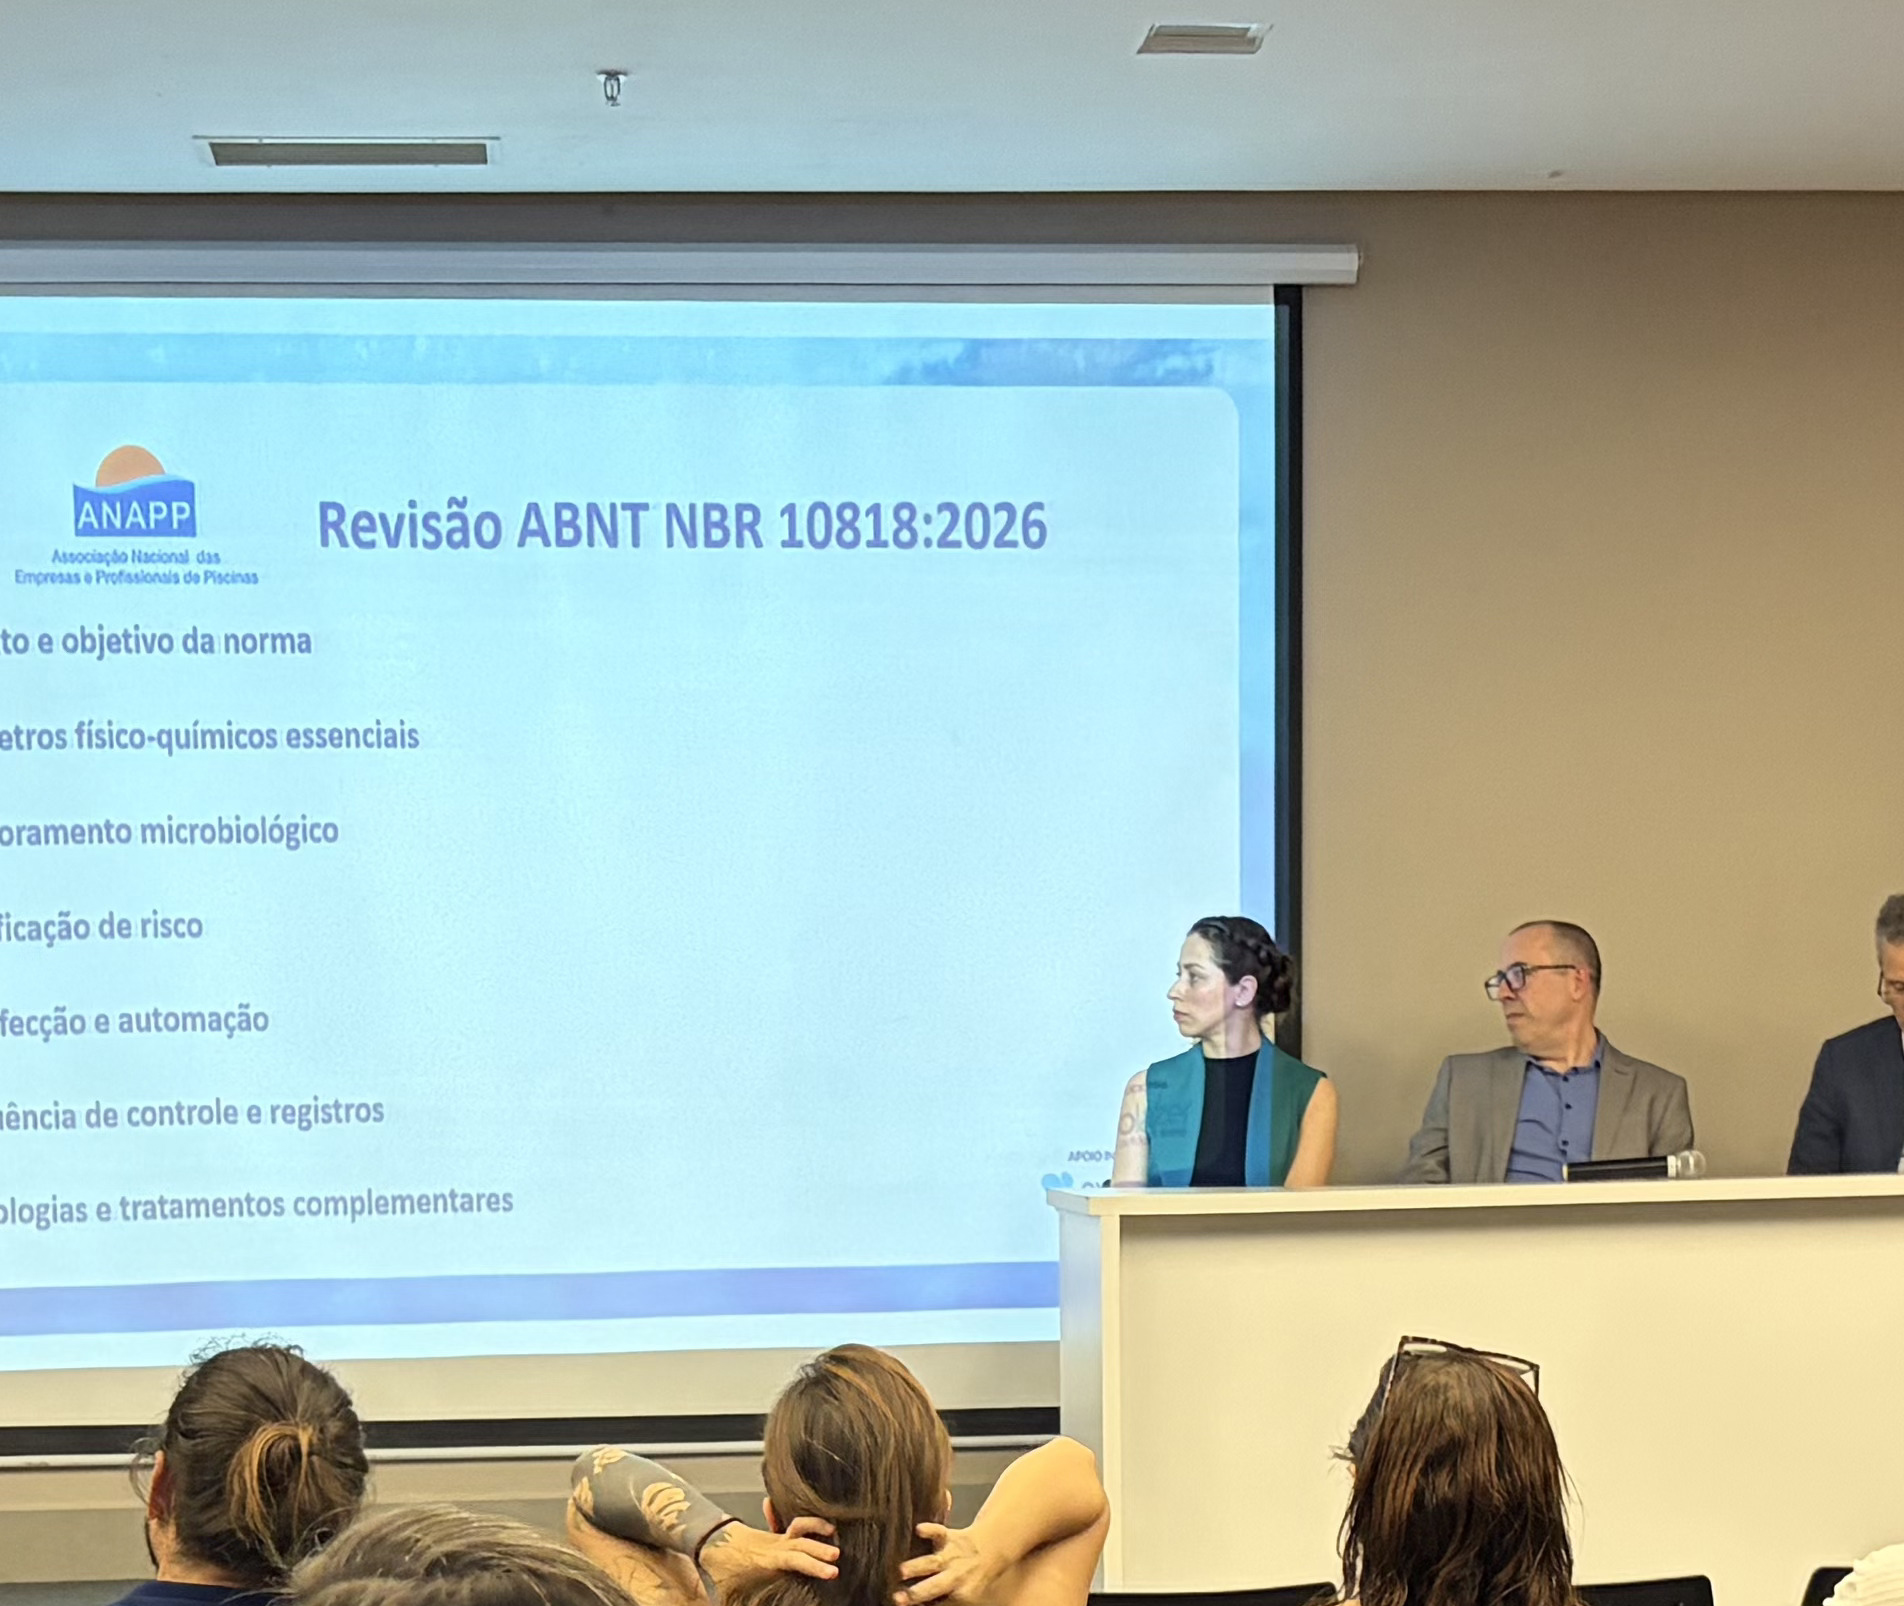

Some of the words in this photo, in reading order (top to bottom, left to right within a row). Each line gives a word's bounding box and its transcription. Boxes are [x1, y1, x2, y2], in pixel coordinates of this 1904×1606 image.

[78, 501, 191, 530] ANAPP
[319, 496, 502, 550] Revisão
[517, 502, 650, 549] ABNT
[666, 502, 764, 549] NBR
[780, 501, 1047, 550] 10818:2026
[131, 549, 189, 564] Nacional
[197, 550, 221, 564] das
[37, 633, 53, 654] e
[62, 623, 174, 661] objetivo
[182, 625, 215, 655] da
[224, 632, 312, 654] norma
[74, 719, 278, 757] físico-químicos
[286, 719, 420, 749] essenciais
[140, 813, 339, 851] microbiológico
[98, 910, 132, 940] de
[141, 909, 203, 939] risco
[94, 1013, 110, 1034] e
[119, 1002, 269, 1039] automação
[85, 1100, 118, 1129] de
[127, 1097, 238, 1127] controle
[246, 1104, 262, 1124] e
[270, 1094, 384, 1132] registros
[96, 1202, 112, 1222] e
[119, 1192, 286, 1222] tratamentos
[293, 1187, 513, 1224] complementares
